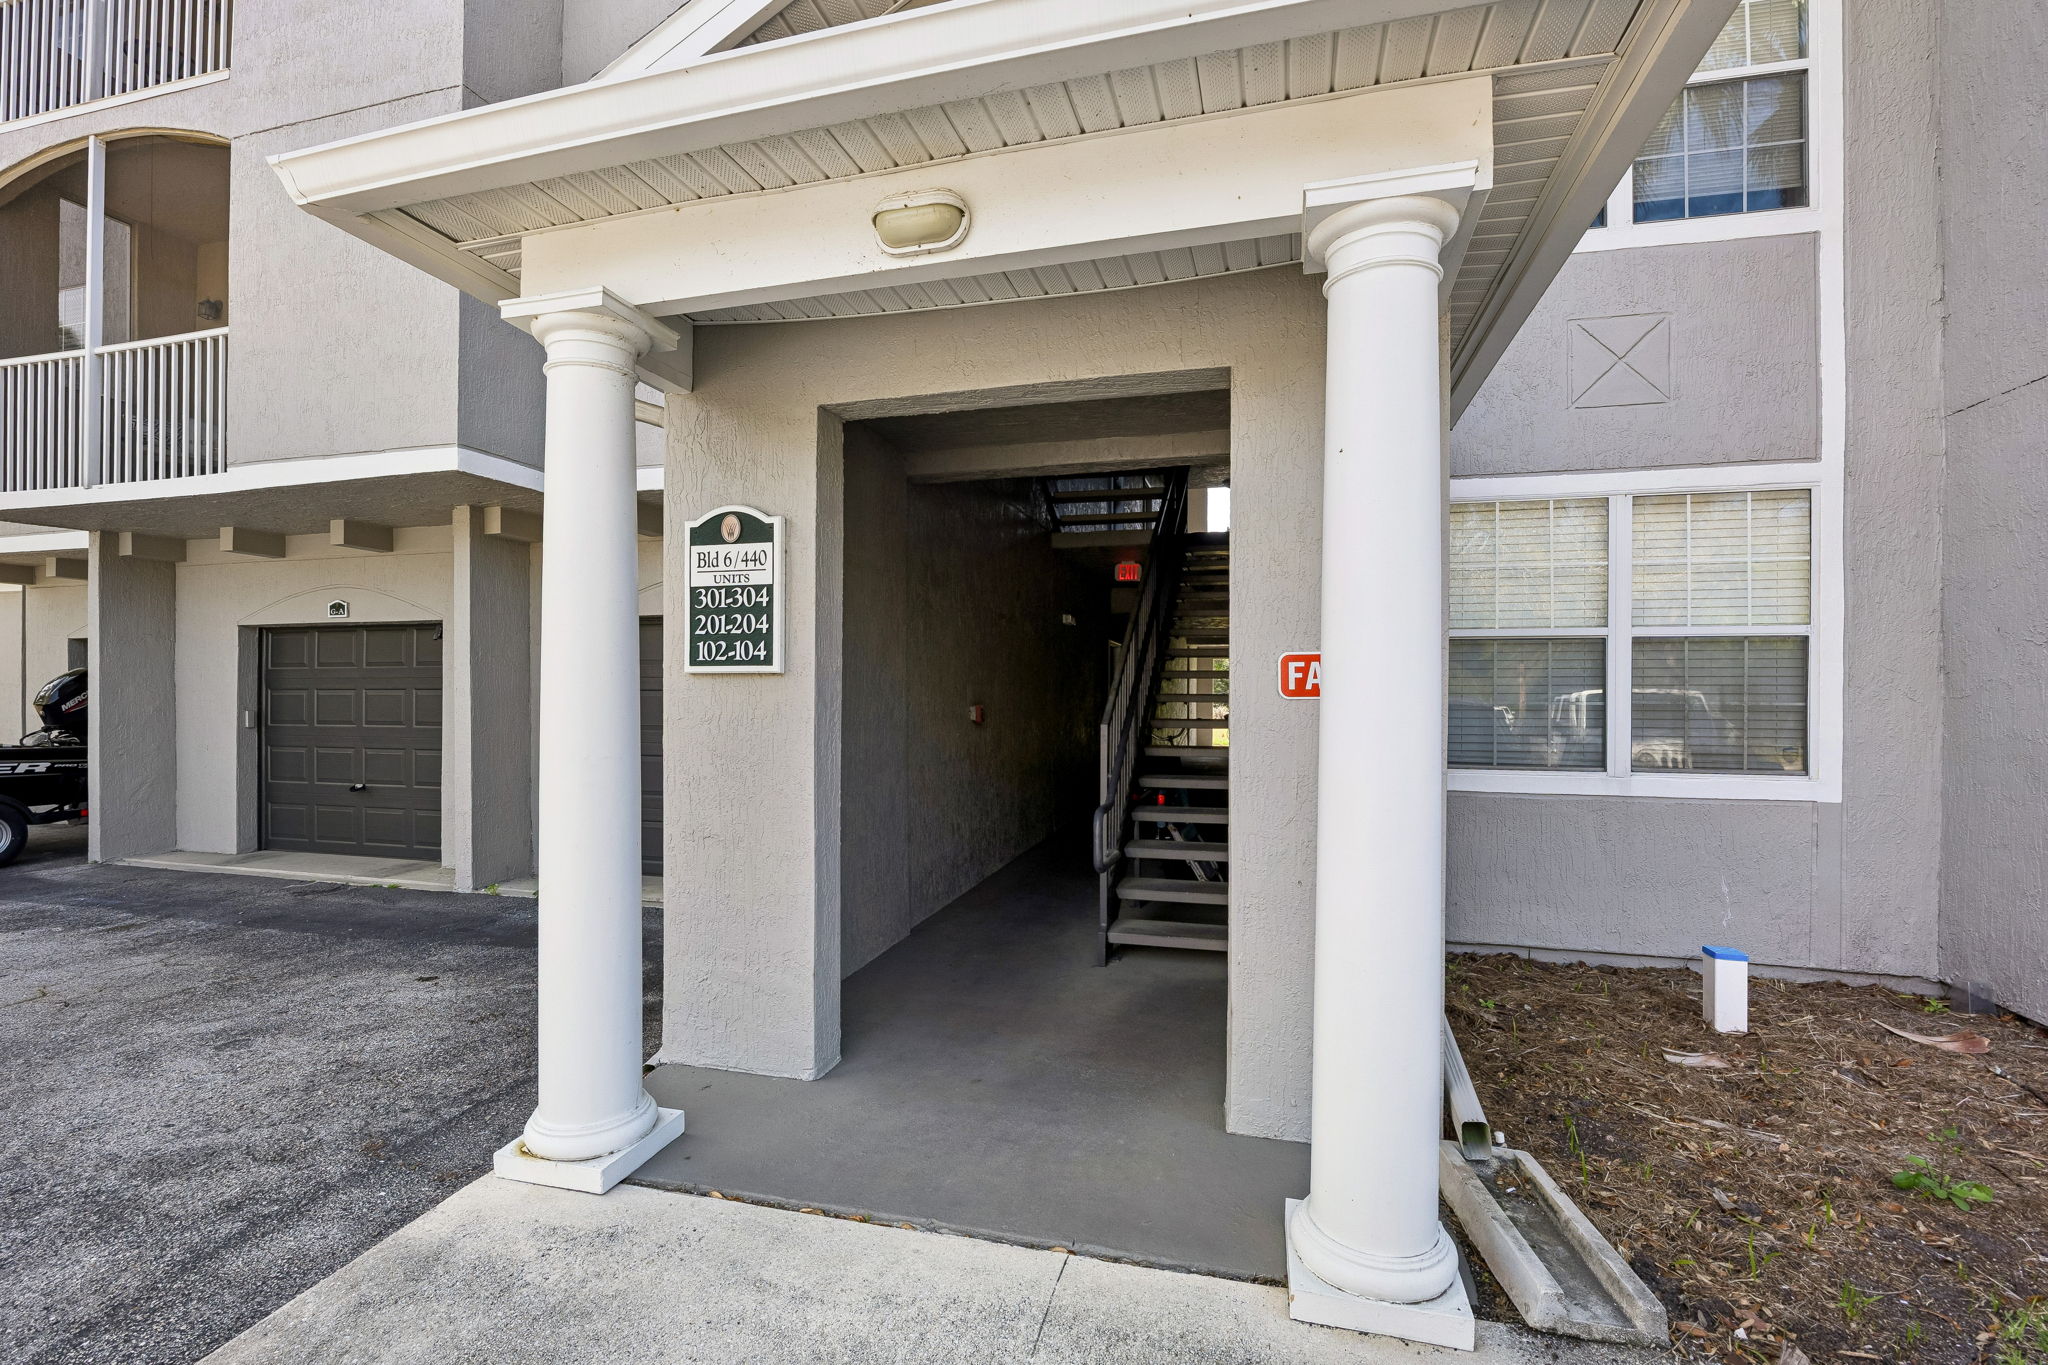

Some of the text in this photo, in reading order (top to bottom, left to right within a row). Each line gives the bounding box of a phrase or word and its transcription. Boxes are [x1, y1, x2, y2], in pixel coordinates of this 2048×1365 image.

[696, 549, 768, 569] Bld 6/440
[713, 573, 750, 584] UNITS
[1119, 564, 1140, 580] EXIT
[694, 586, 770, 609] 301-304
[694, 613, 770, 635] 201-204
[696, 640, 767, 661] 102-104
